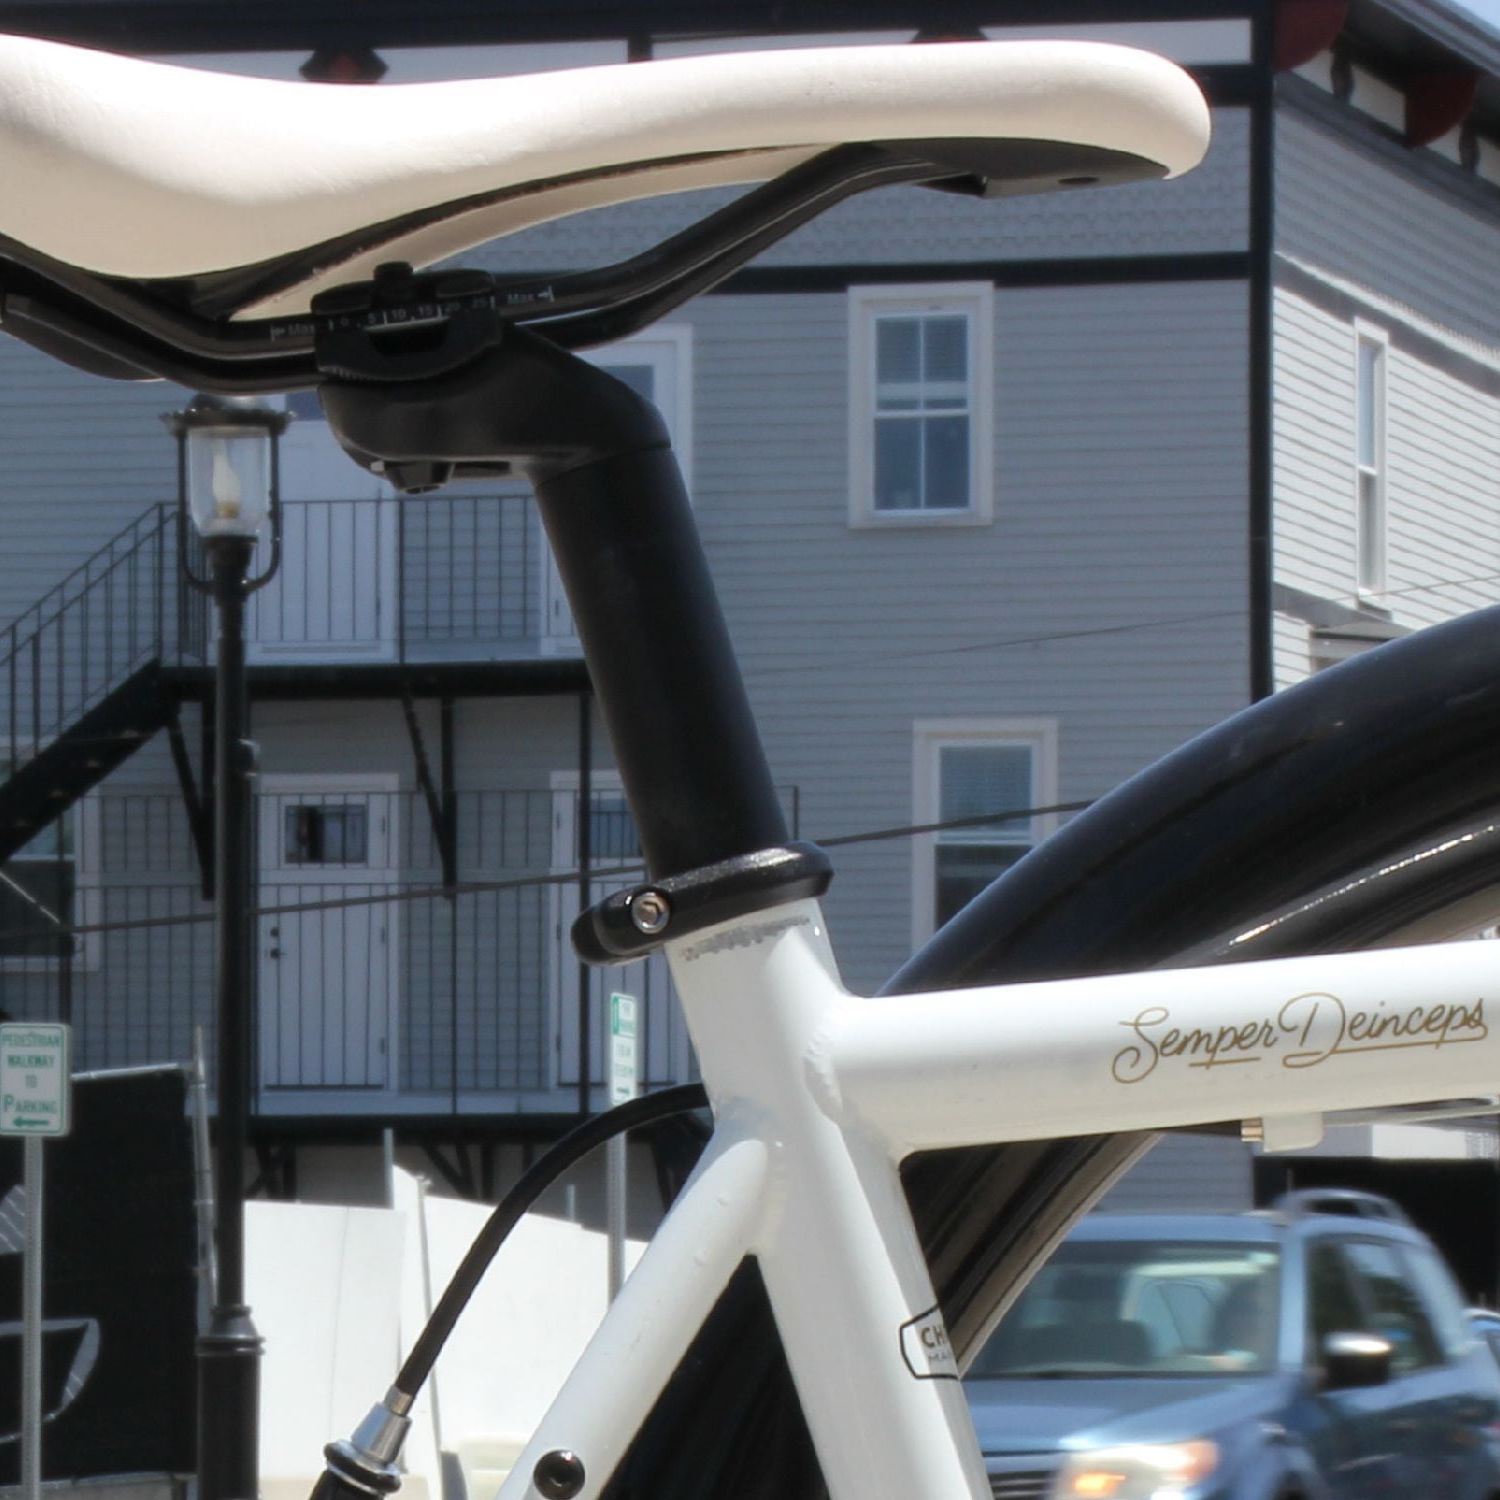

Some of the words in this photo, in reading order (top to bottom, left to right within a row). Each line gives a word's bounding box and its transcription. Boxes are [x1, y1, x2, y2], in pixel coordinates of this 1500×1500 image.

[7, 1054, 55, 1068] WALKWAY
[1112, 1007, 1278, 1084] Semper
[1277, 992, 1488, 1070] Deinceps
